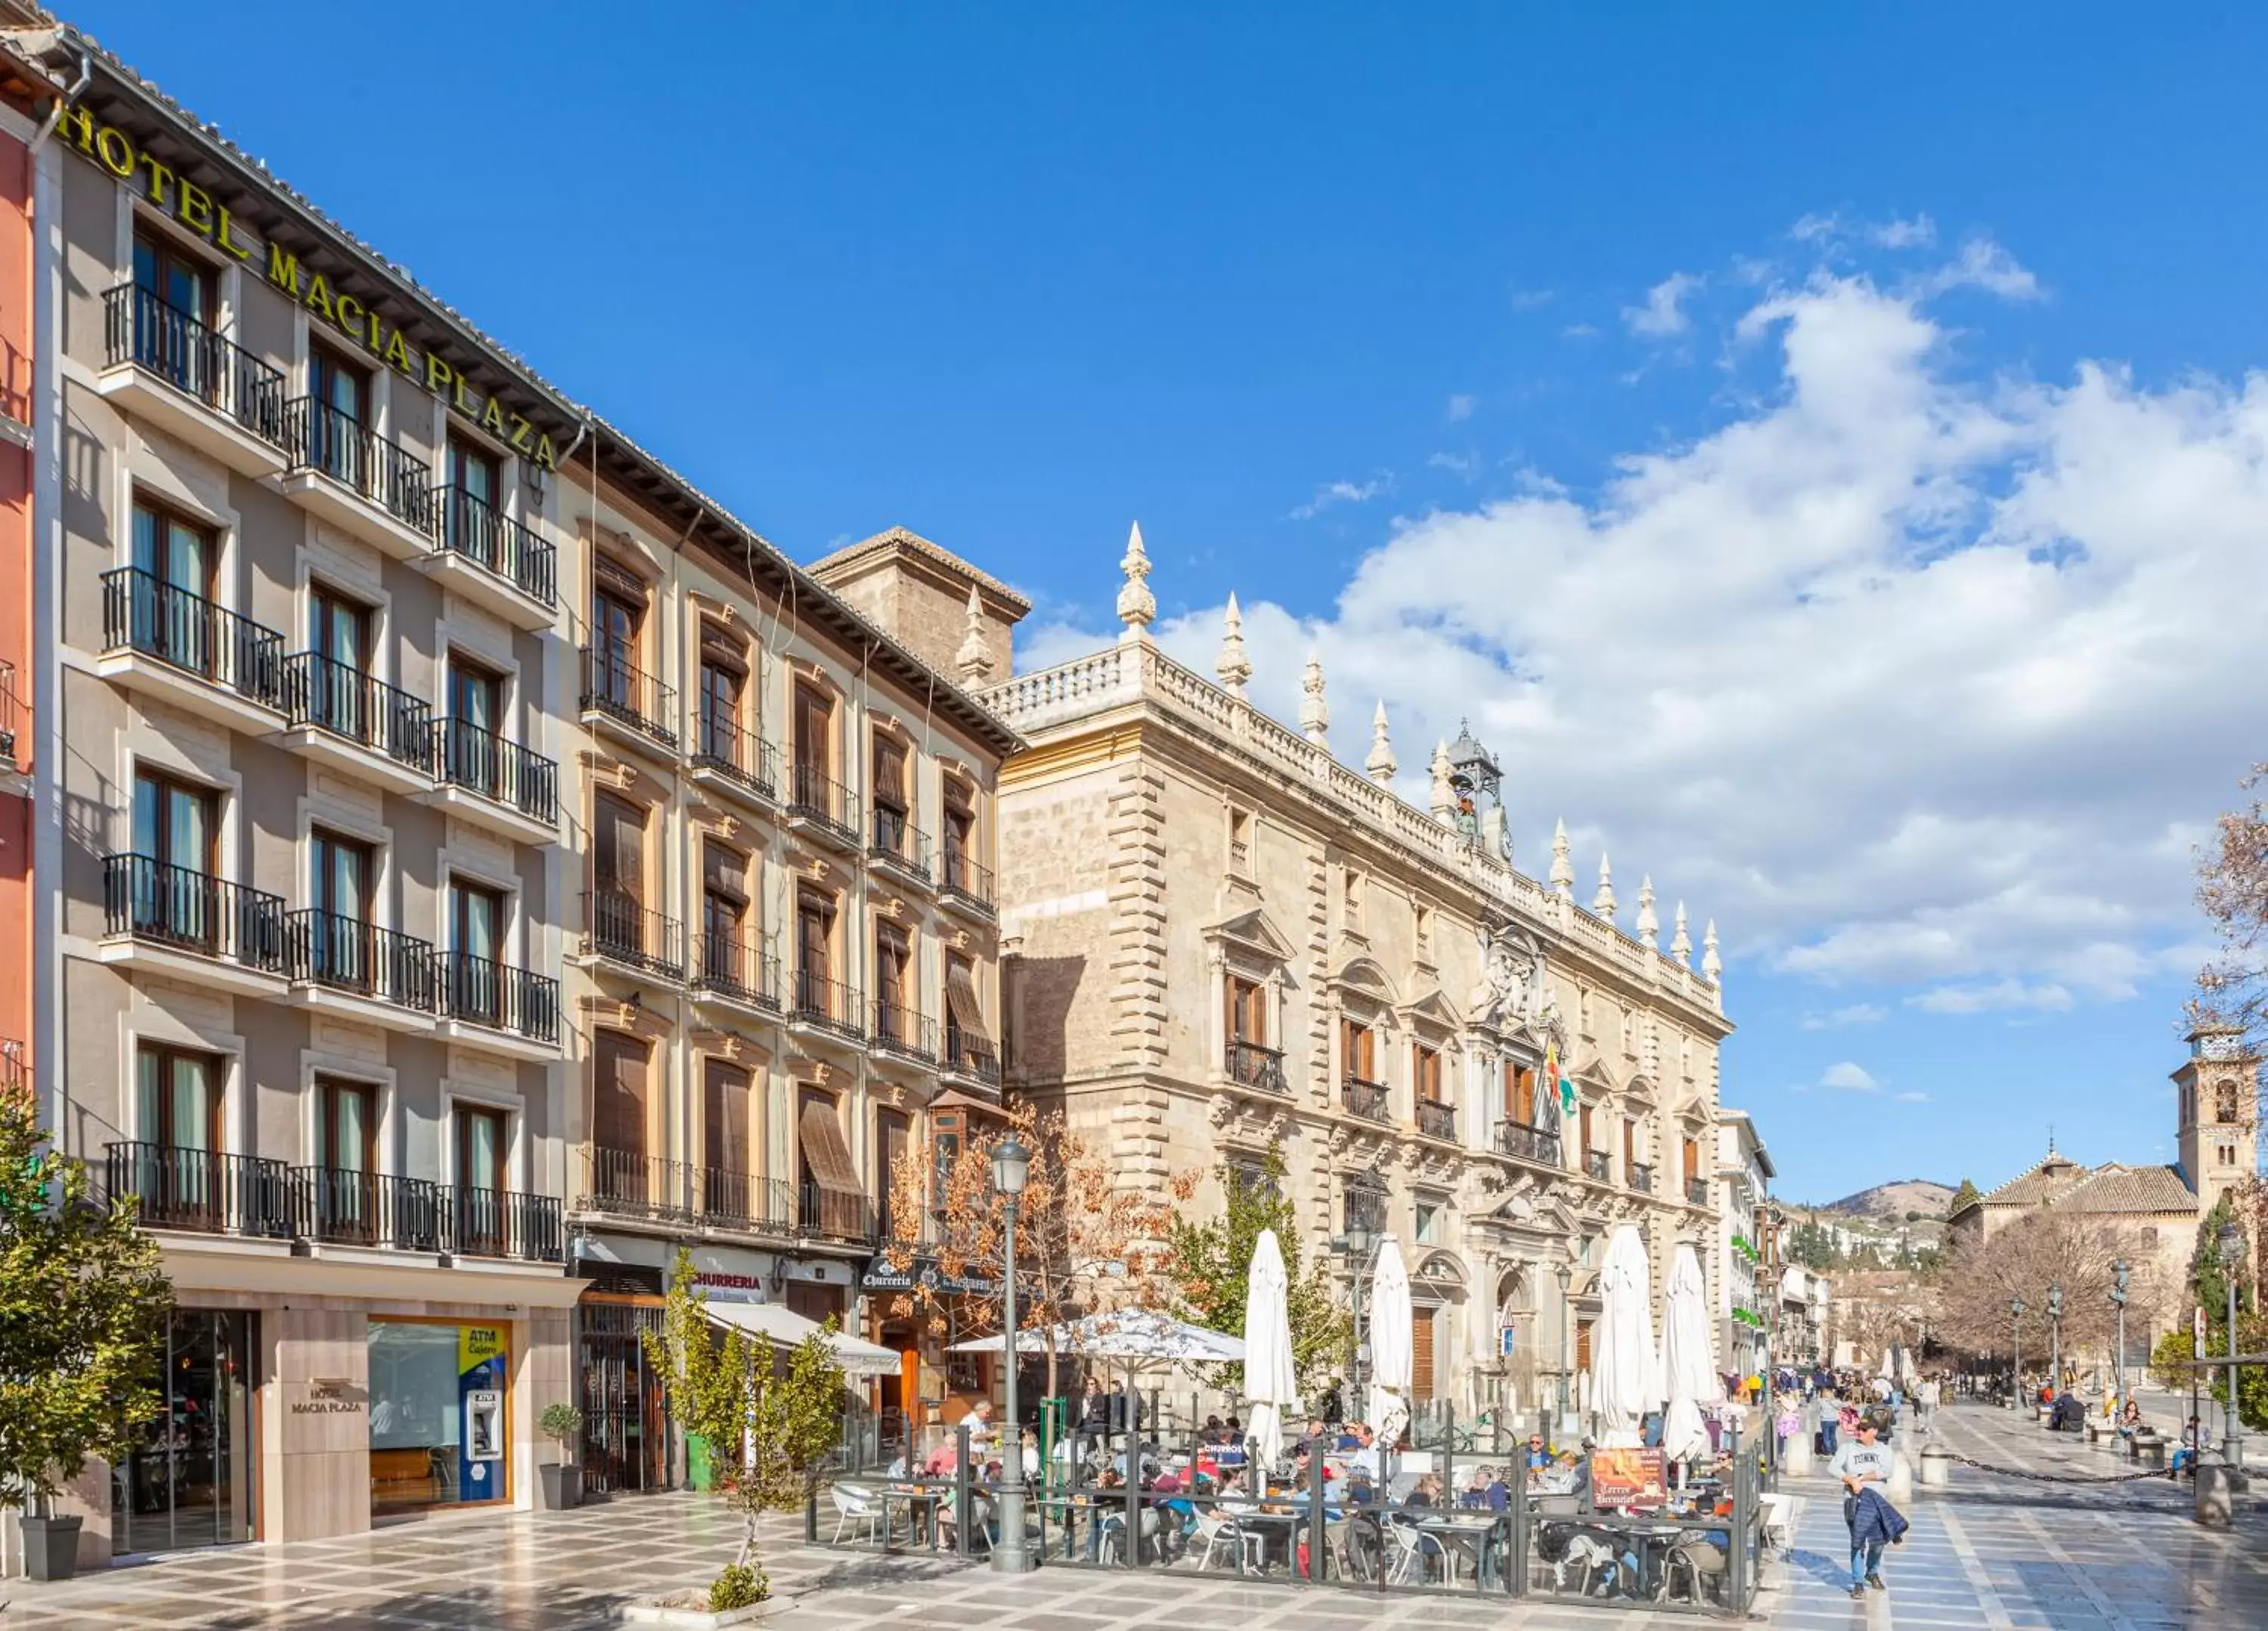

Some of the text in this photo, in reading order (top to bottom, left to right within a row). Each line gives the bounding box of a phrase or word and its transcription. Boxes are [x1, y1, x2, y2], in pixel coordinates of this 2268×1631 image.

[56, 105, 557, 472] HOTEL MACIA PLAZA
[469, 1330, 496, 1342] ATM
[310, 1388, 344, 1400] HOTEL
[329, 1402, 361, 1413] PLAZA
